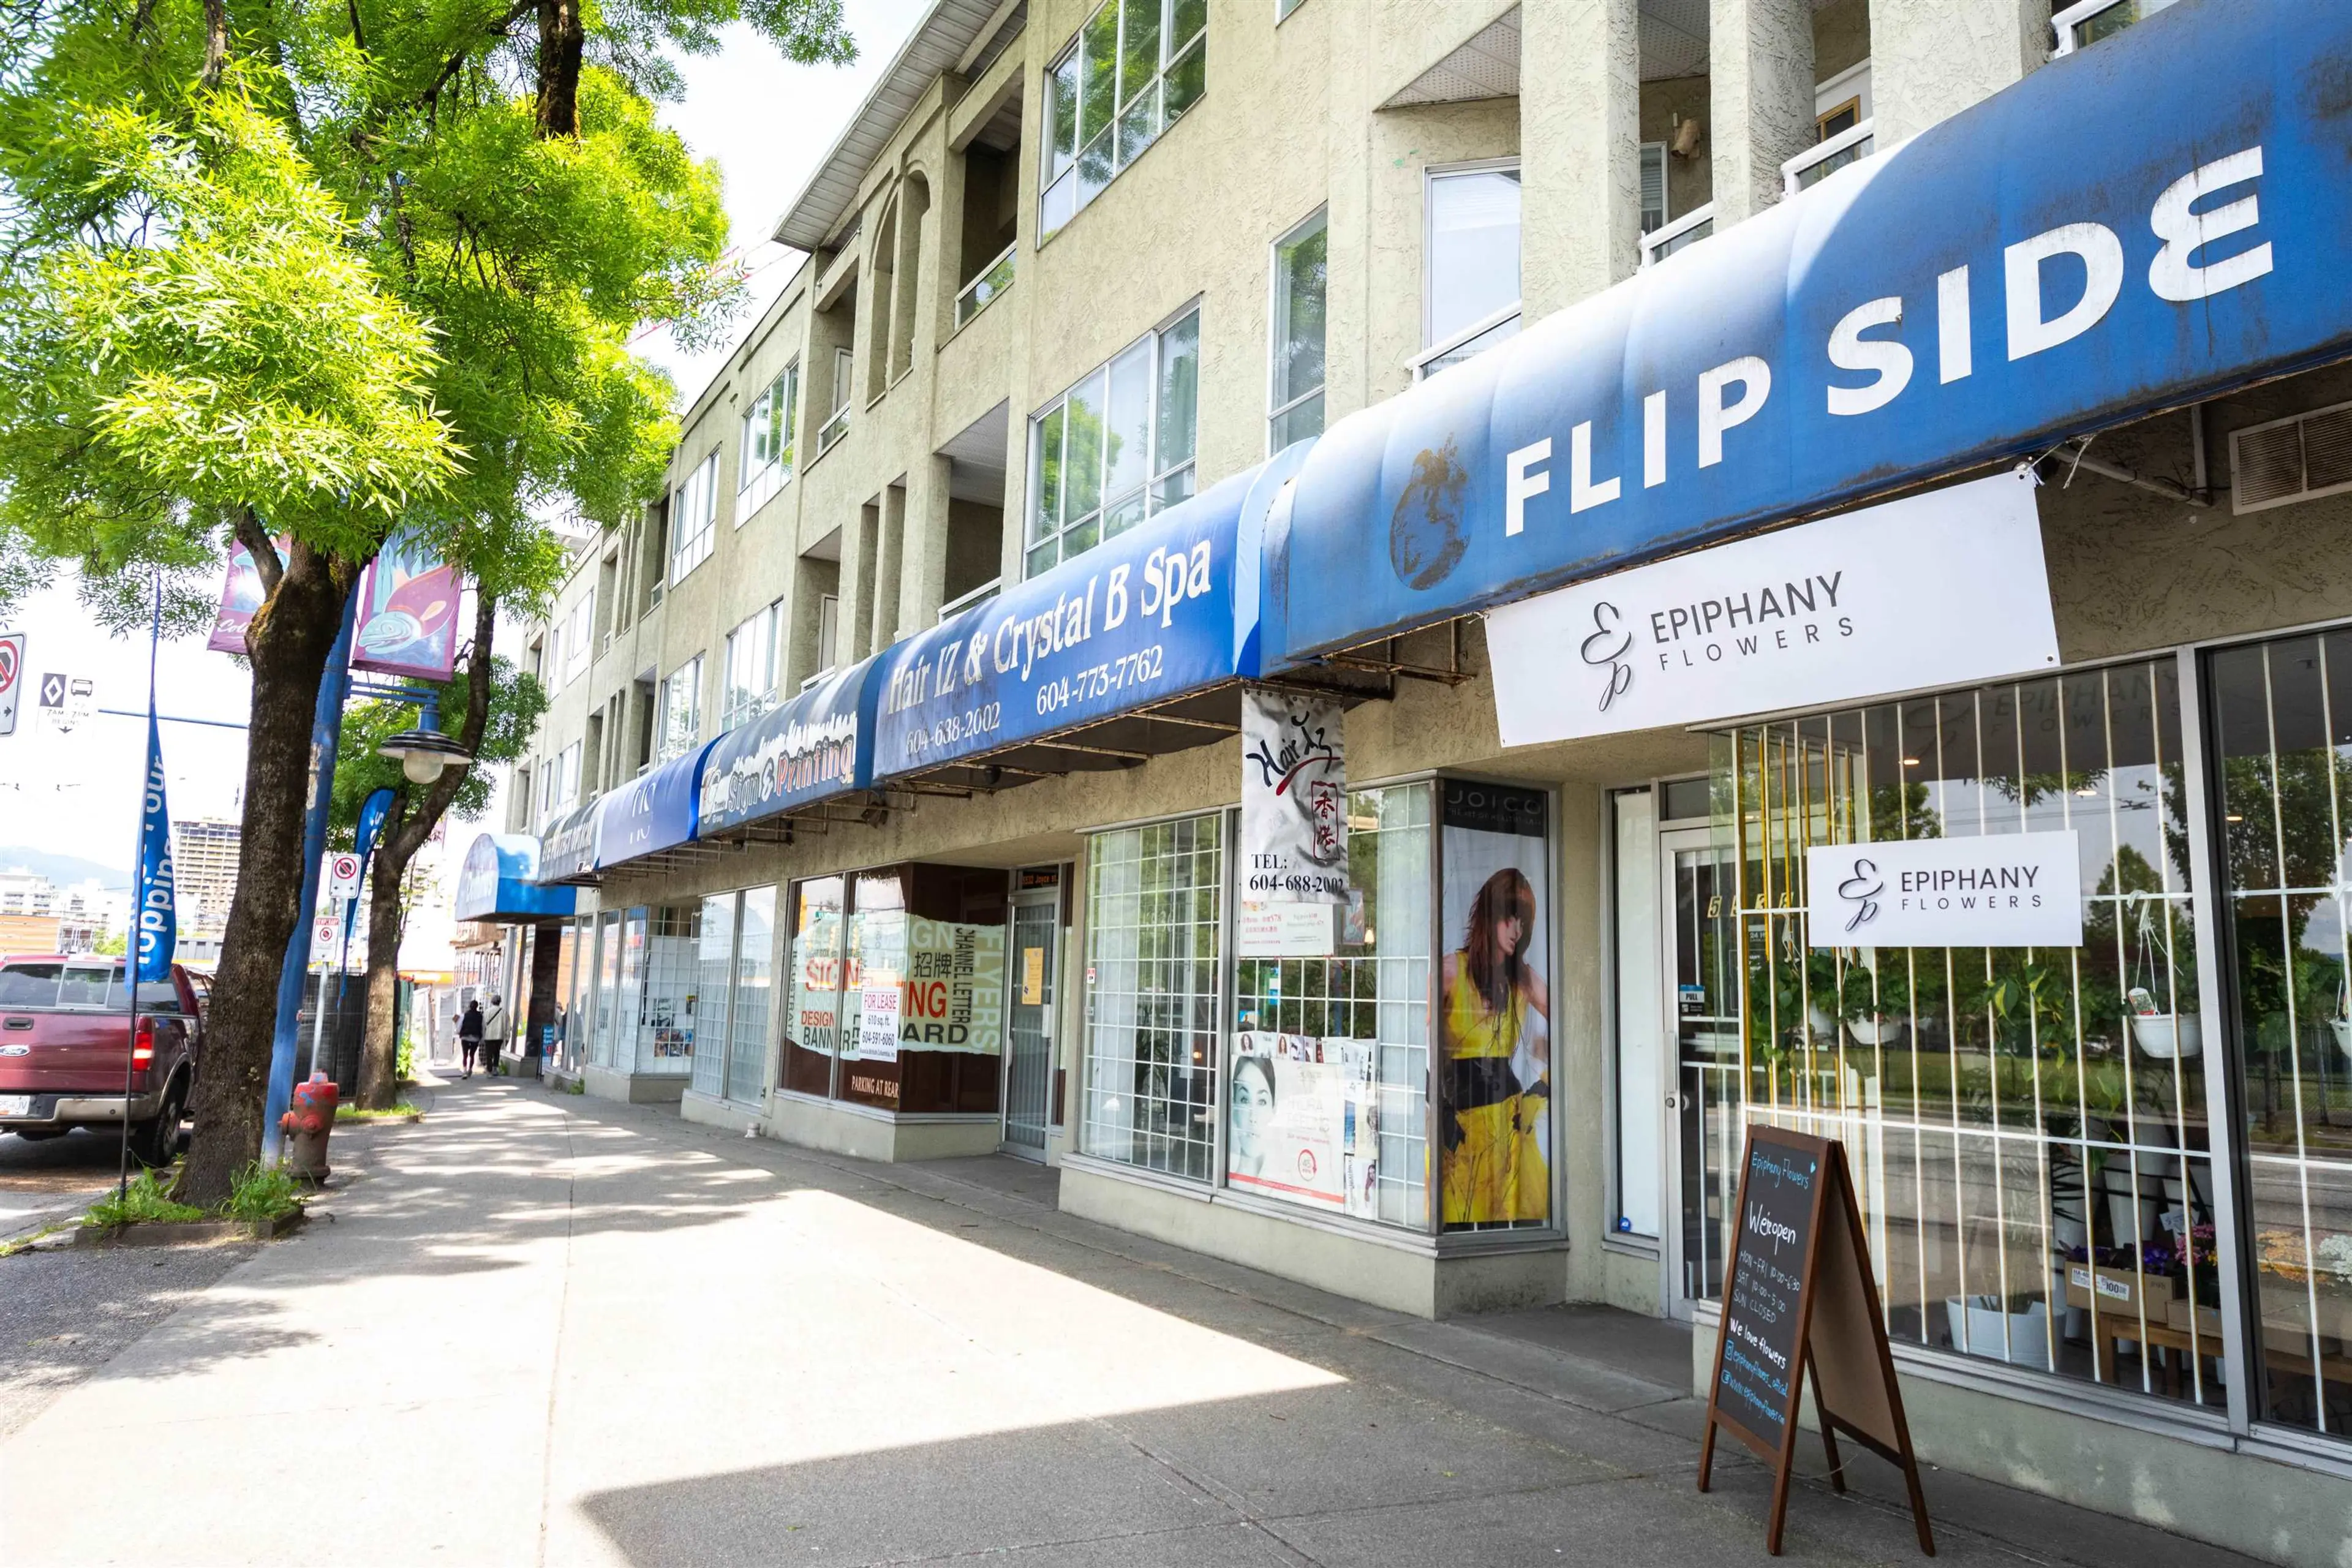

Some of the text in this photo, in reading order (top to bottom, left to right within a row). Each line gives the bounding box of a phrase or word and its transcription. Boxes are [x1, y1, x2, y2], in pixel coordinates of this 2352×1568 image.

[1506, 145, 2274, 537] FLIP SIDE
[1650, 570, 1842, 644] EPIPHANY
[888, 540, 1212, 715] Hair IZ & Crystal B Spa
[1659, 617, 1853, 671] FLOWERS
[1036, 644, 1163, 715] 604-773-7762
[907, 701, 1001, 755] 604-638-2002
[728, 770, 760, 816] Sign
[761, 757, 775, 802] &
[776, 734, 854, 796] Printing
[1246, 737, 1301, 788] Hair
[145, 754, 165, 831] our
[1447, 790, 1542, 815] JOICO
[1251, 853, 1287, 870] TEL:
[1901, 865, 2039, 892] EPIPHANY
[1250, 873, 1344, 893] 604-688-2002
[1902, 895, 2041, 910] FLOWERS
[914, 952, 952, 979] 招牌
[864, 993, 897, 1010] FOR LEASE
[951, 982, 974, 1024] LETTER
[970, 929, 1005, 1049] FLYERS
[803, 1027, 851, 1052] BANNR
[851, 1075, 899, 1099] PARKING AT REAR
[1752, 1152, 1809, 1190] Epiphany Flowers
[1737, 1269, 1749, 1287] SAT
[1734, 1289, 1776, 1323] SUN CLOSED
[1730, 1317, 1787, 1370] We love flowers
